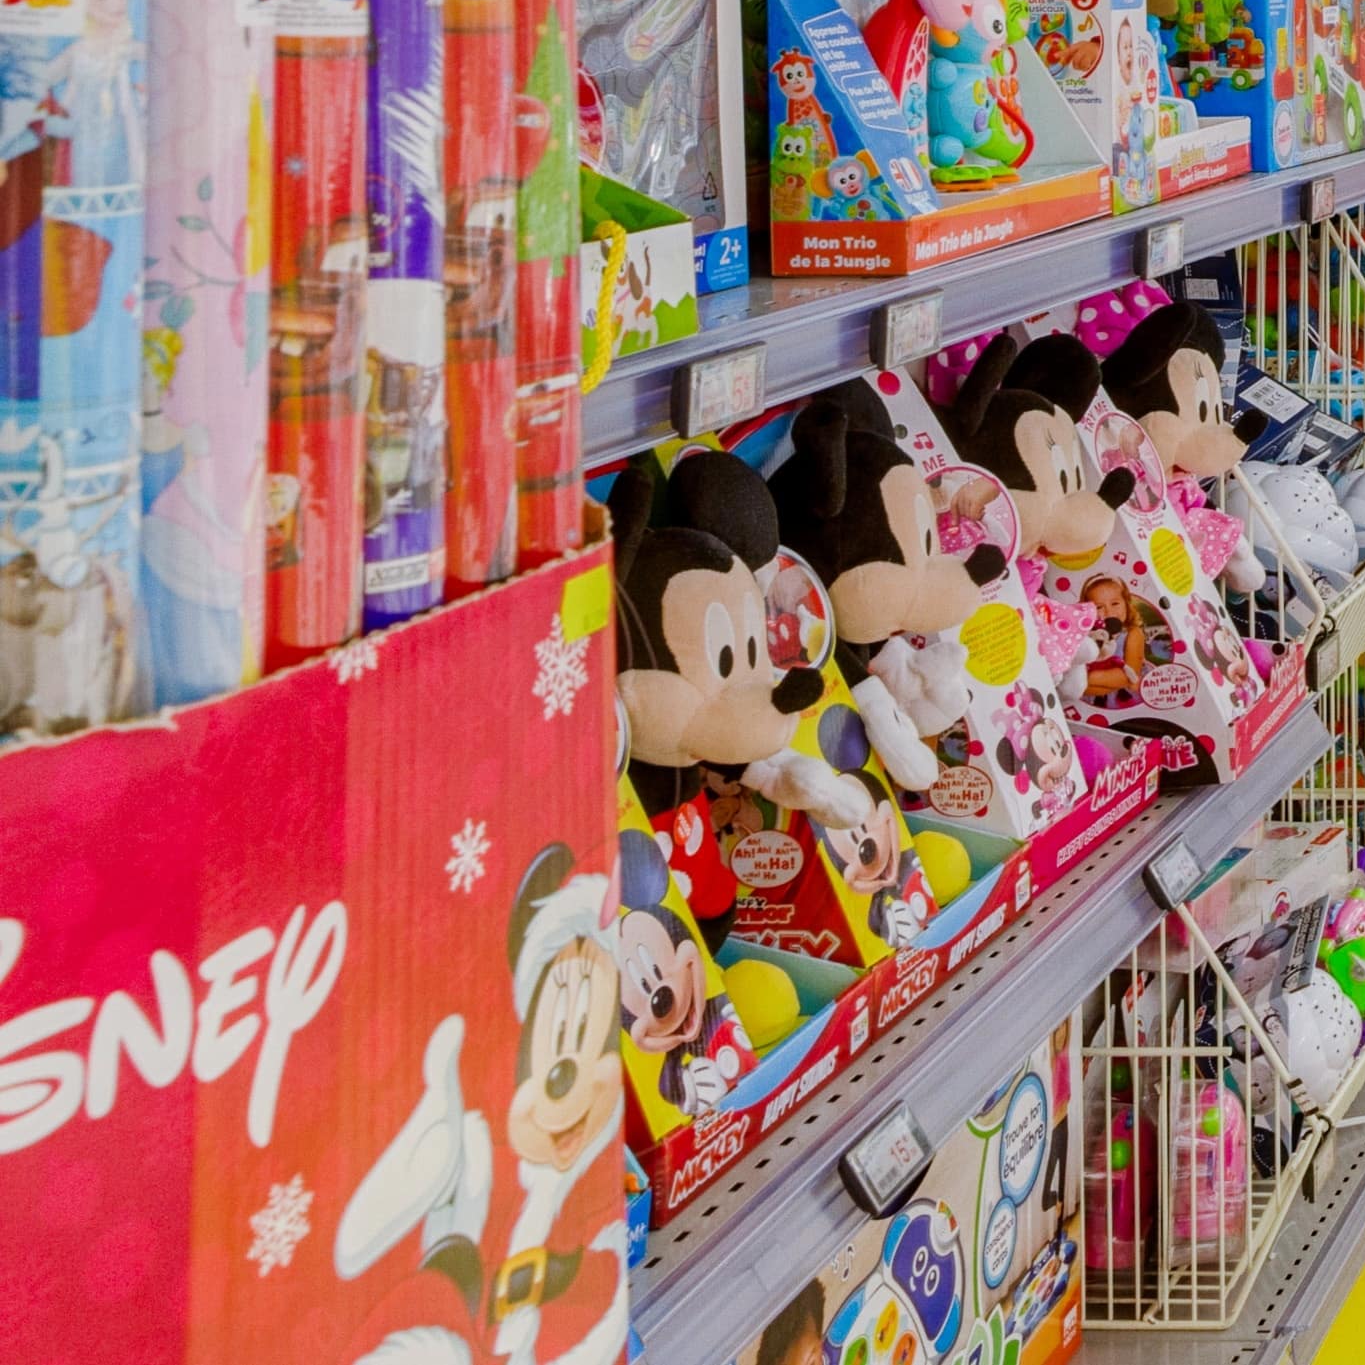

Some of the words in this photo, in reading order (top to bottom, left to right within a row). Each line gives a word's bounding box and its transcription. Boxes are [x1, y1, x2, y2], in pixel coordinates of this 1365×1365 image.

[803, 237, 842, 251] Mon
[845, 236, 876, 251] Trio
[915, 239, 939, 262] Mon
[940, 236, 959, 256] Trio
[983, 220, 1014, 247] Jungle
[720, 237, 740, 265] 2+
[790, 255, 811, 268] de
[815, 254, 831, 268] la
[833, 254, 892, 271] Jungle
[922, 454, 946, 472] ME
[1171, 684, 1191, 694] Ha!
[1091, 751, 1147, 811] MINNIE
[962, 789, 985, 801] Ha!
[735, 848, 756, 858] Ah!
[769, 857, 796, 870] Ha!
[877, 955, 938, 1028] MICKEY
[1005, 1117, 1029, 1148] Trouve
[668, 1115, 750, 1209] MICKEY
